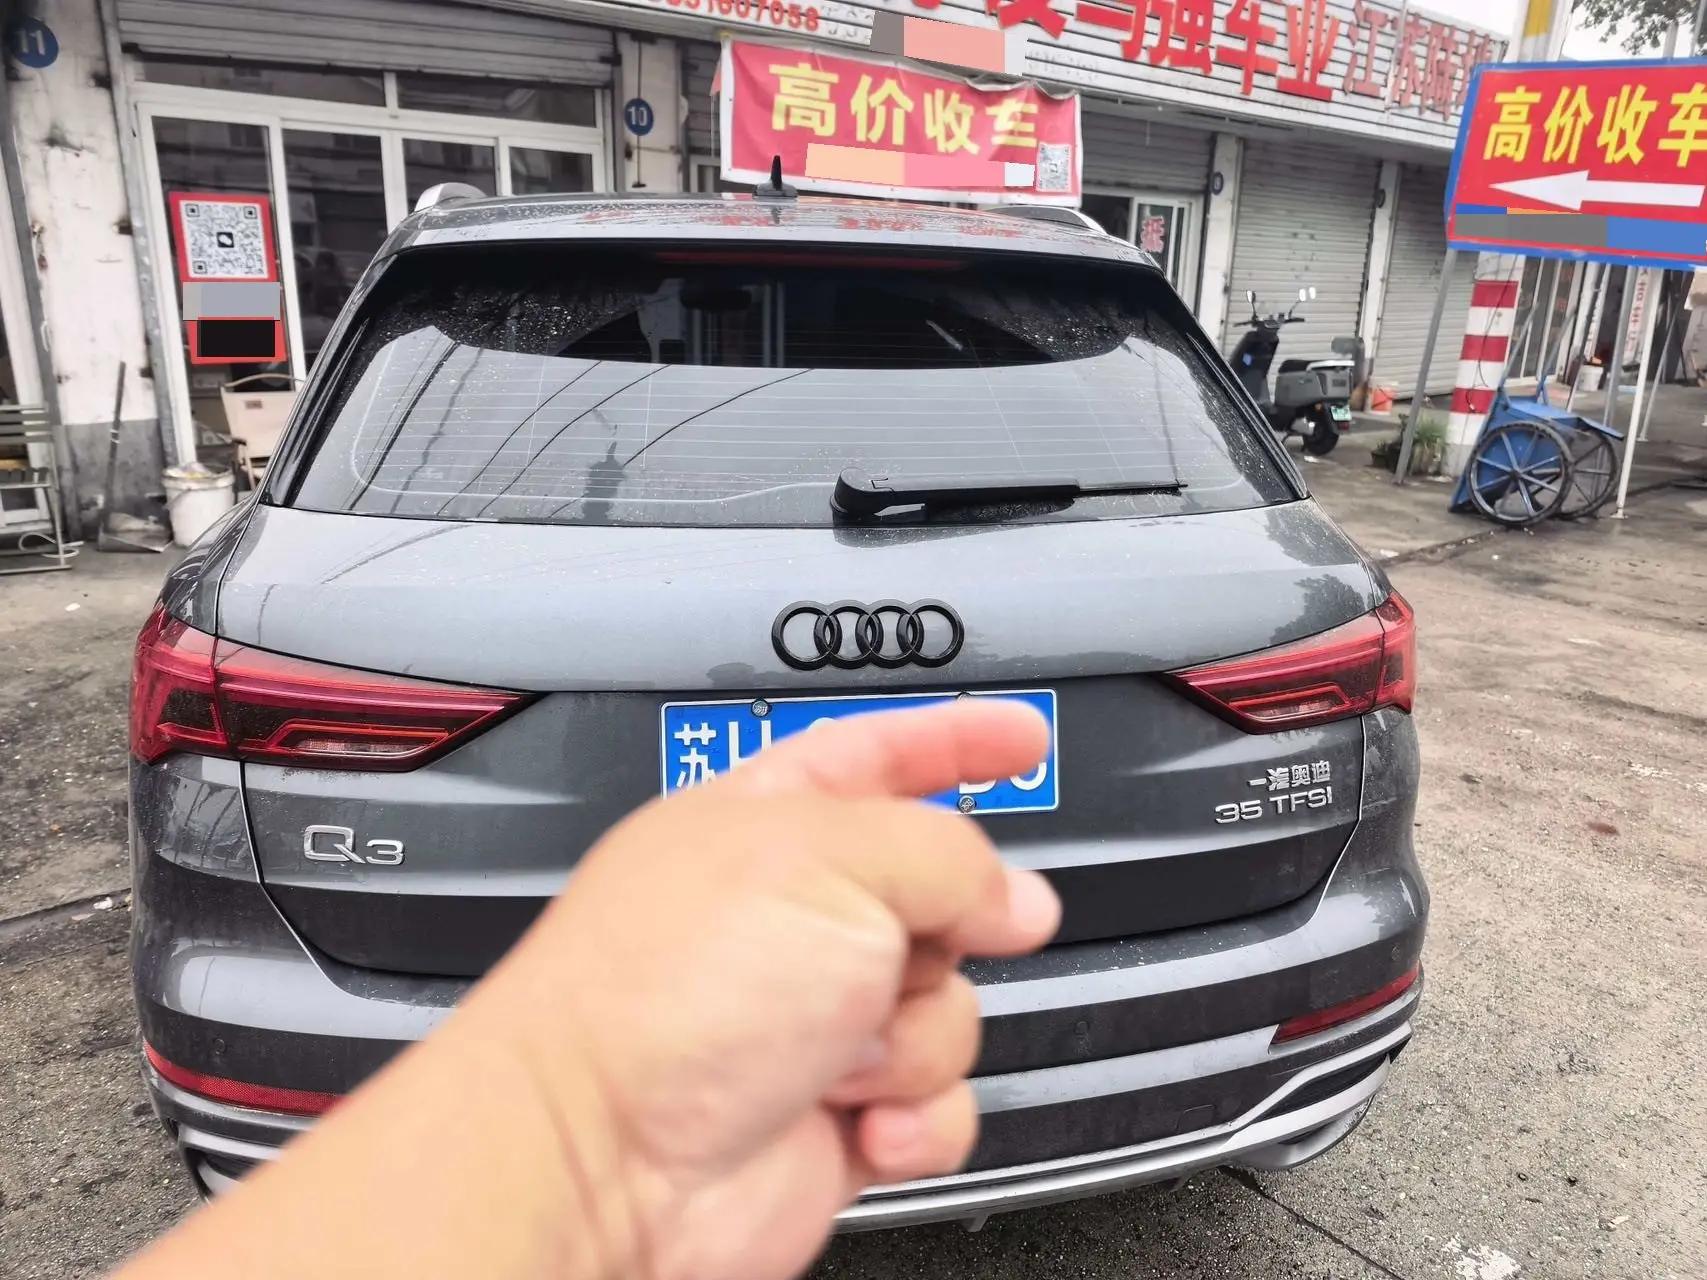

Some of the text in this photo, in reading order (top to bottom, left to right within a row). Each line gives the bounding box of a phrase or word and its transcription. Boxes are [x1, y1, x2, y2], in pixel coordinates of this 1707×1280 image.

[16, 29, 46, 56] 11
[627, 106, 648, 127] 10
[768, 62, 1039, 156] 高价收车
[1482, 82, 1707, 168] 高价收车
[1247, 760, 1331, 791] 一汽奥迪
[1214, 786, 1333, 824] 35 TFSI
[303, 824, 407, 866] Q3
